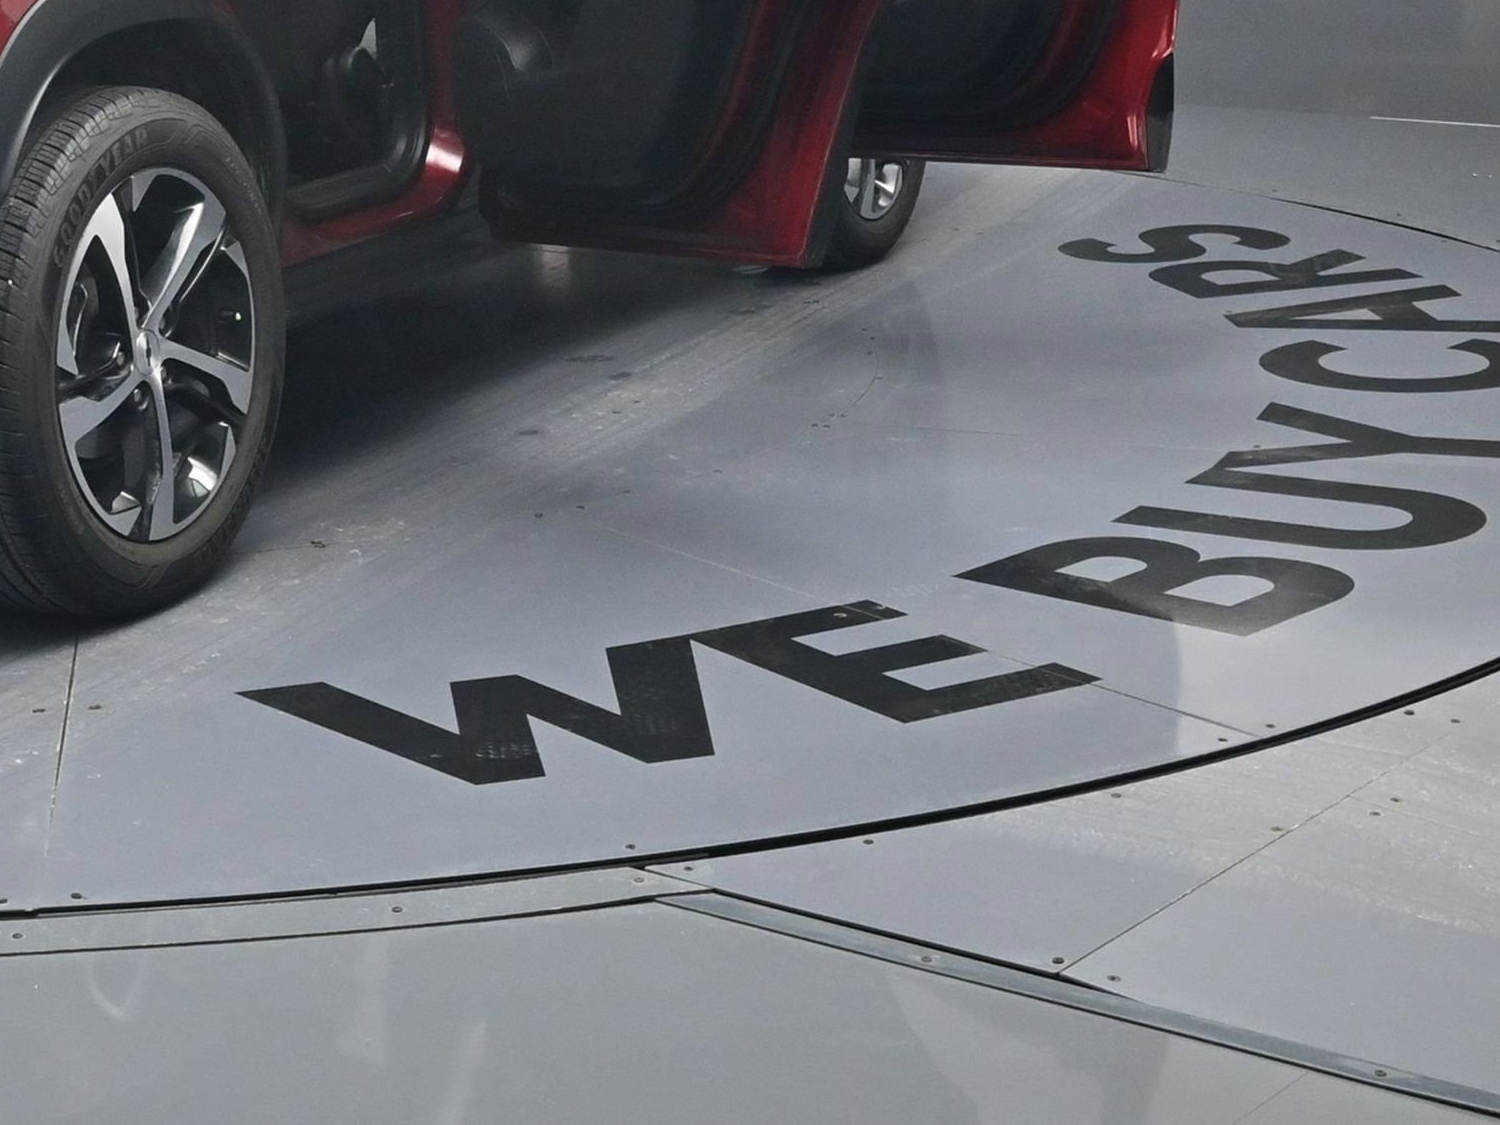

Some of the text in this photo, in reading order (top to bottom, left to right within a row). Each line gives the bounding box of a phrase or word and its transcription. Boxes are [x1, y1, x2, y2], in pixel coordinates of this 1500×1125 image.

[236, 224, 1500, 786] WE BUY CARS
